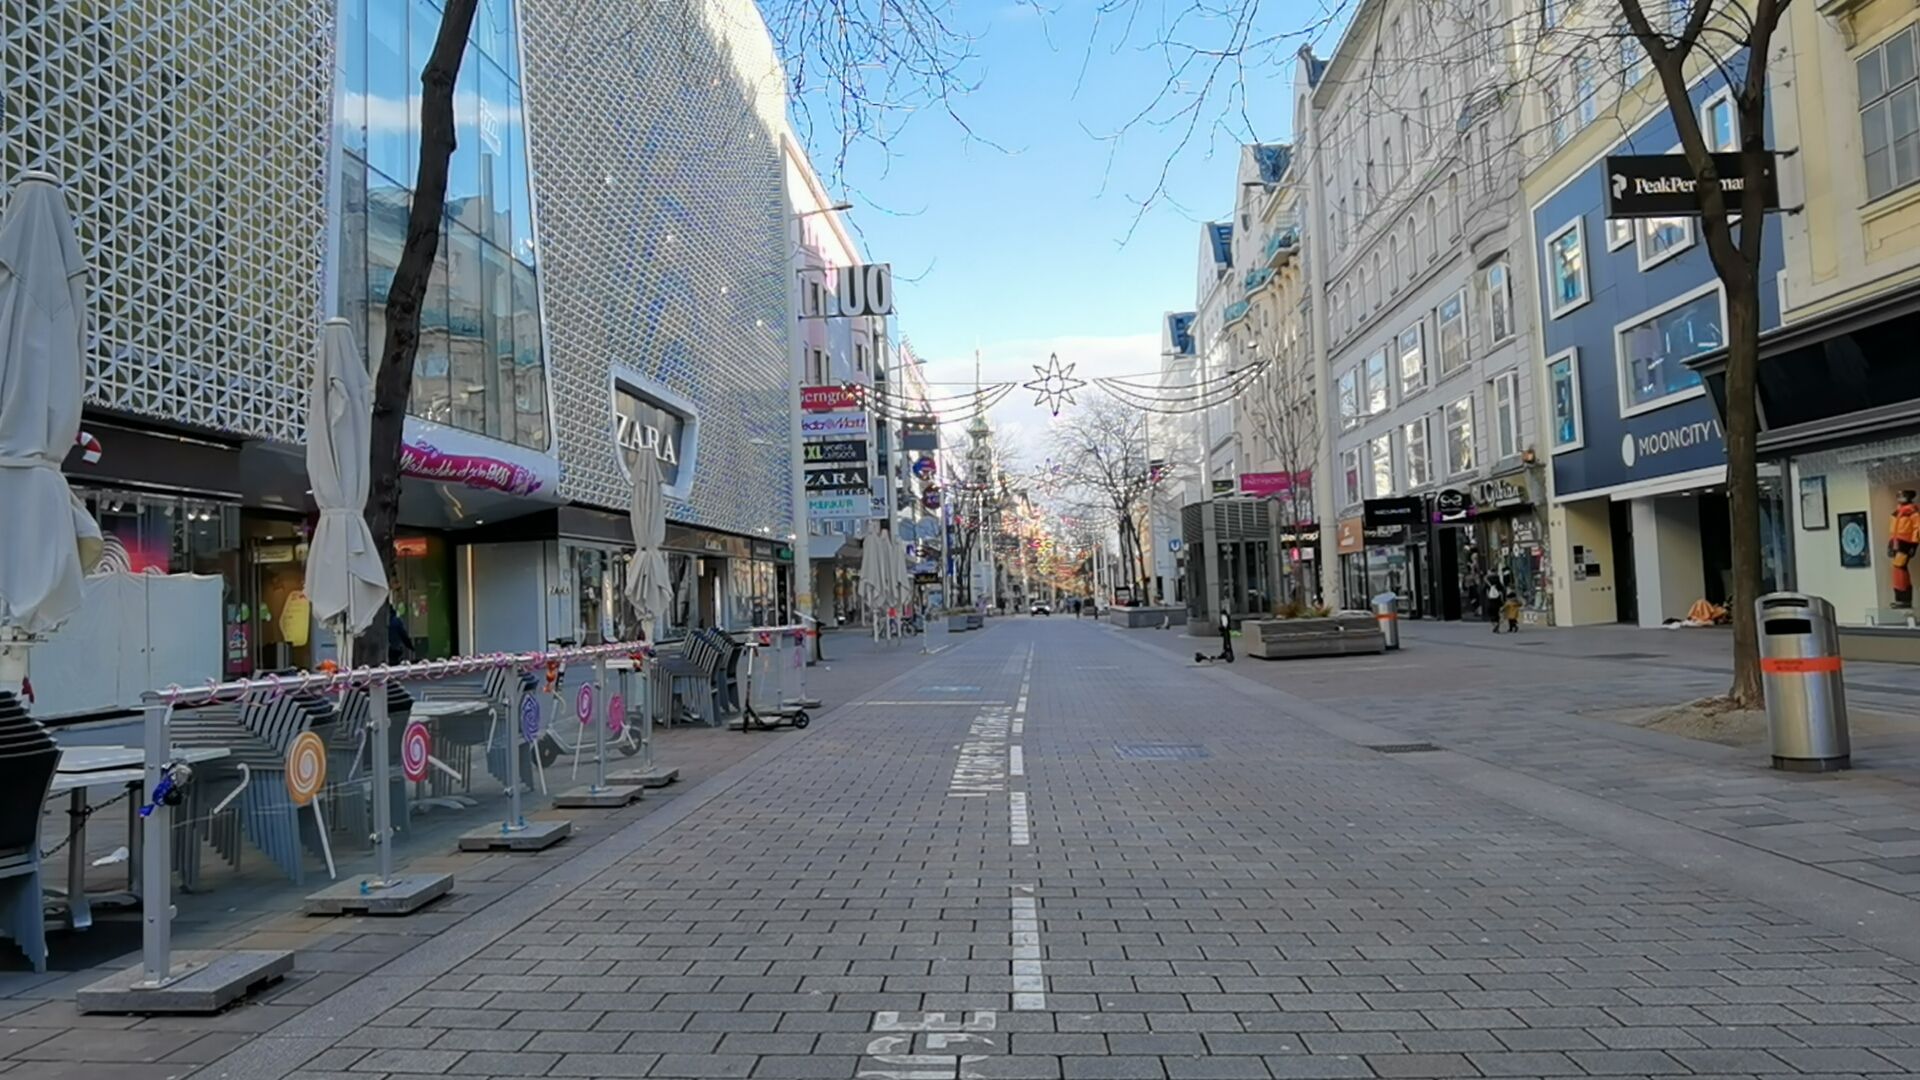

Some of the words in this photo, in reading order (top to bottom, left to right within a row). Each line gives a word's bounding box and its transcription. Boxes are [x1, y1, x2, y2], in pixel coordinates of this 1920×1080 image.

[616, 412, 678, 466] ZARA
[1639, 421, 1711, 456] MOONCITY
[805, 471, 865, 486] ZARA
